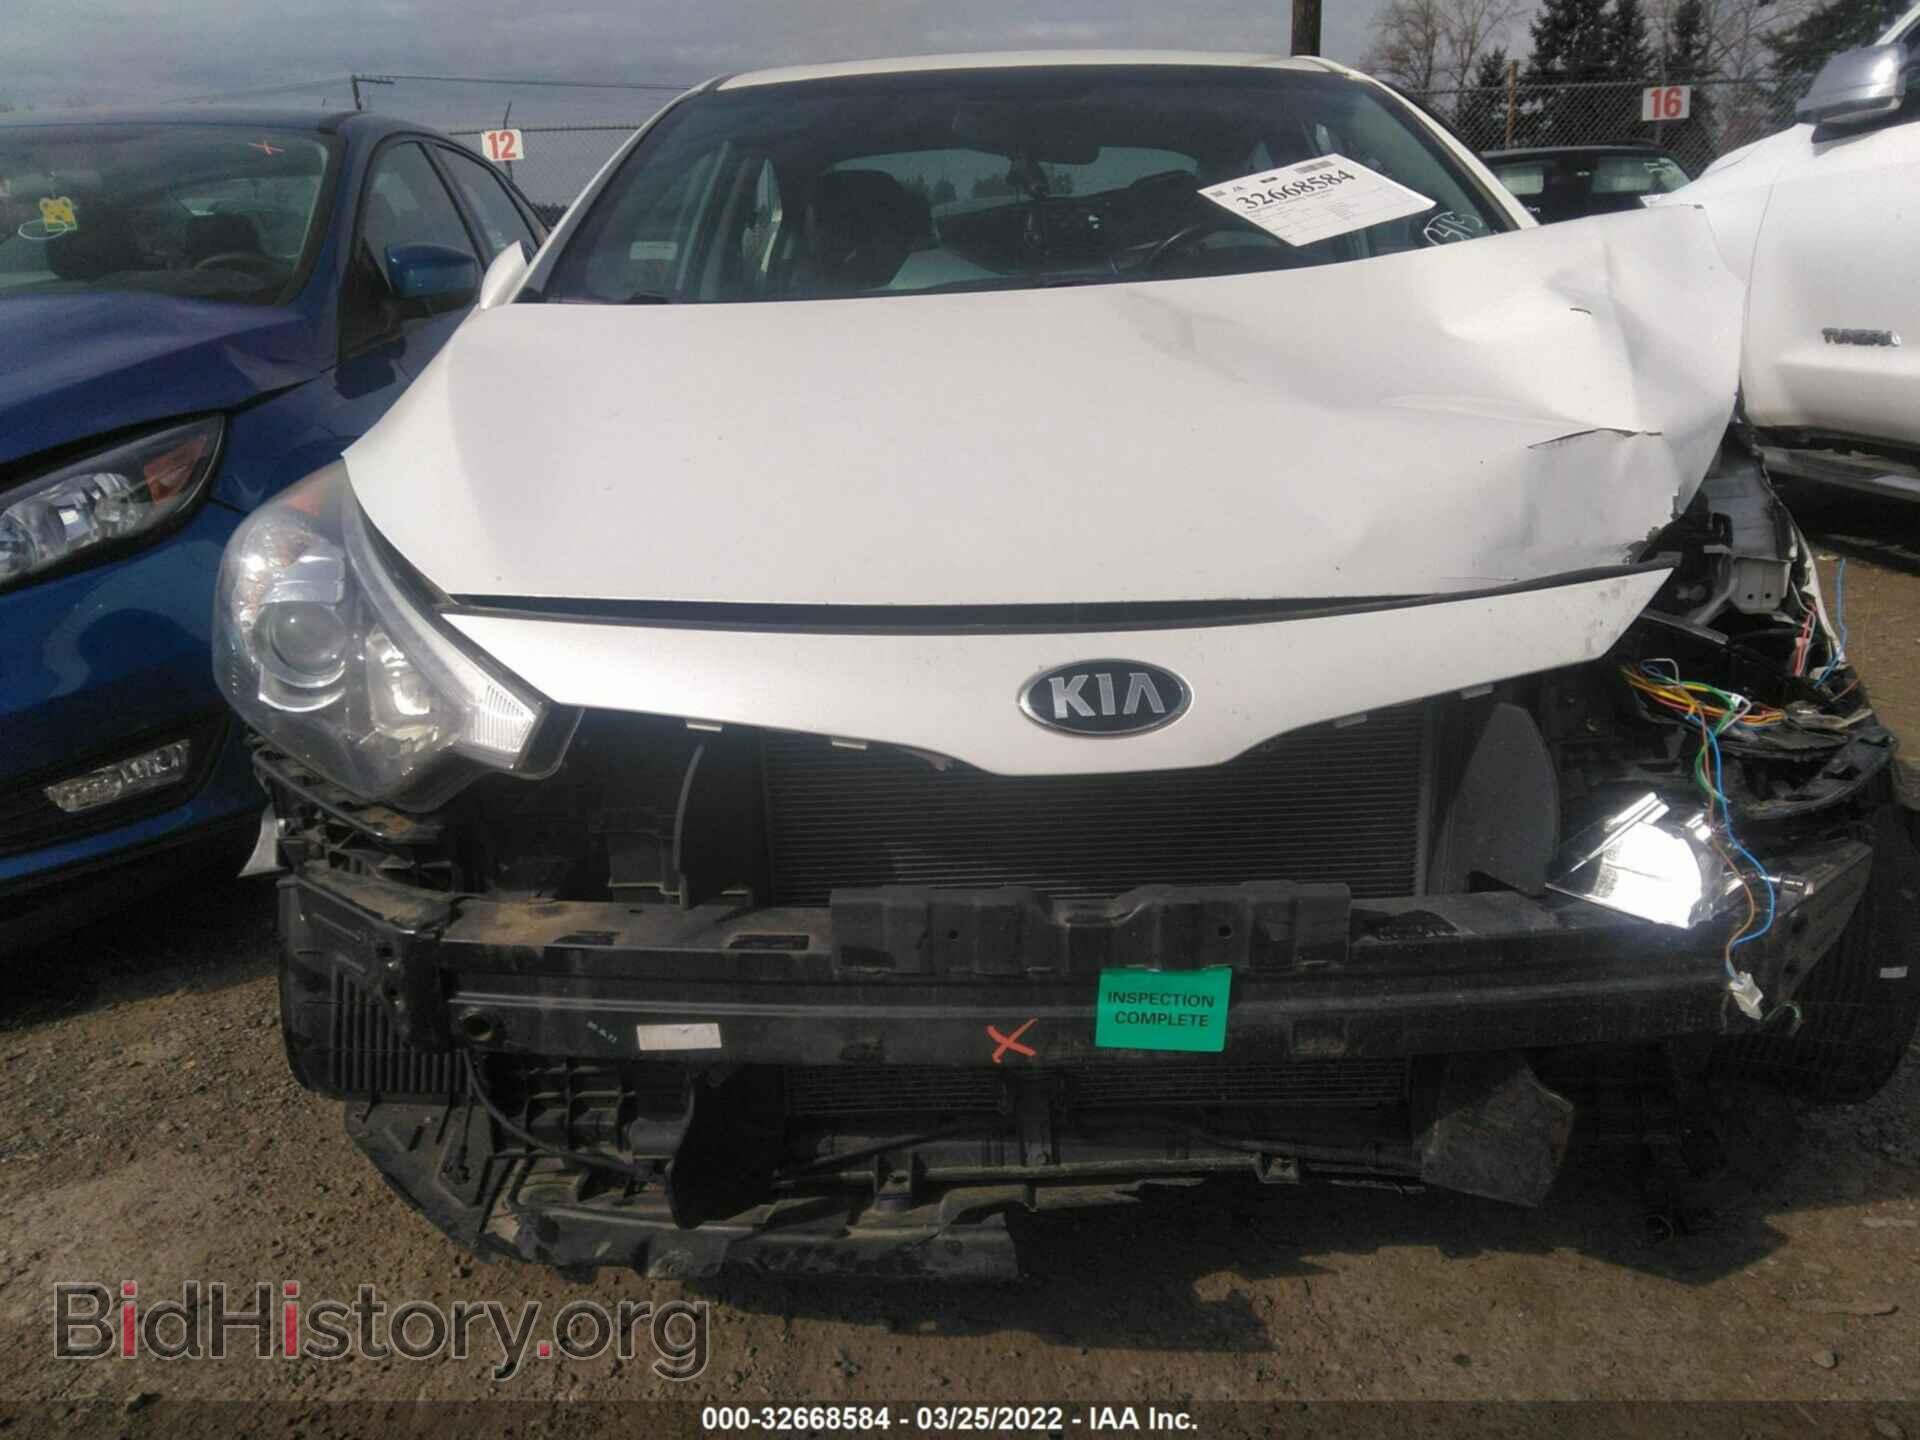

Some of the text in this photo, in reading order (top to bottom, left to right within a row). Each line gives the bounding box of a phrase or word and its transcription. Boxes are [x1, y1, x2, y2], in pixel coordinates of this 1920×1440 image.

[1651, 86, 1682, 118] 16
[488, 131, 517, 159] 12
[1236, 168, 1356, 210] 32668584
[1048, 672, 1166, 719] KIA
[1107, 991, 1215, 1008] INSPECTION
[1114, 1011, 1209, 1027] COMPLETE
